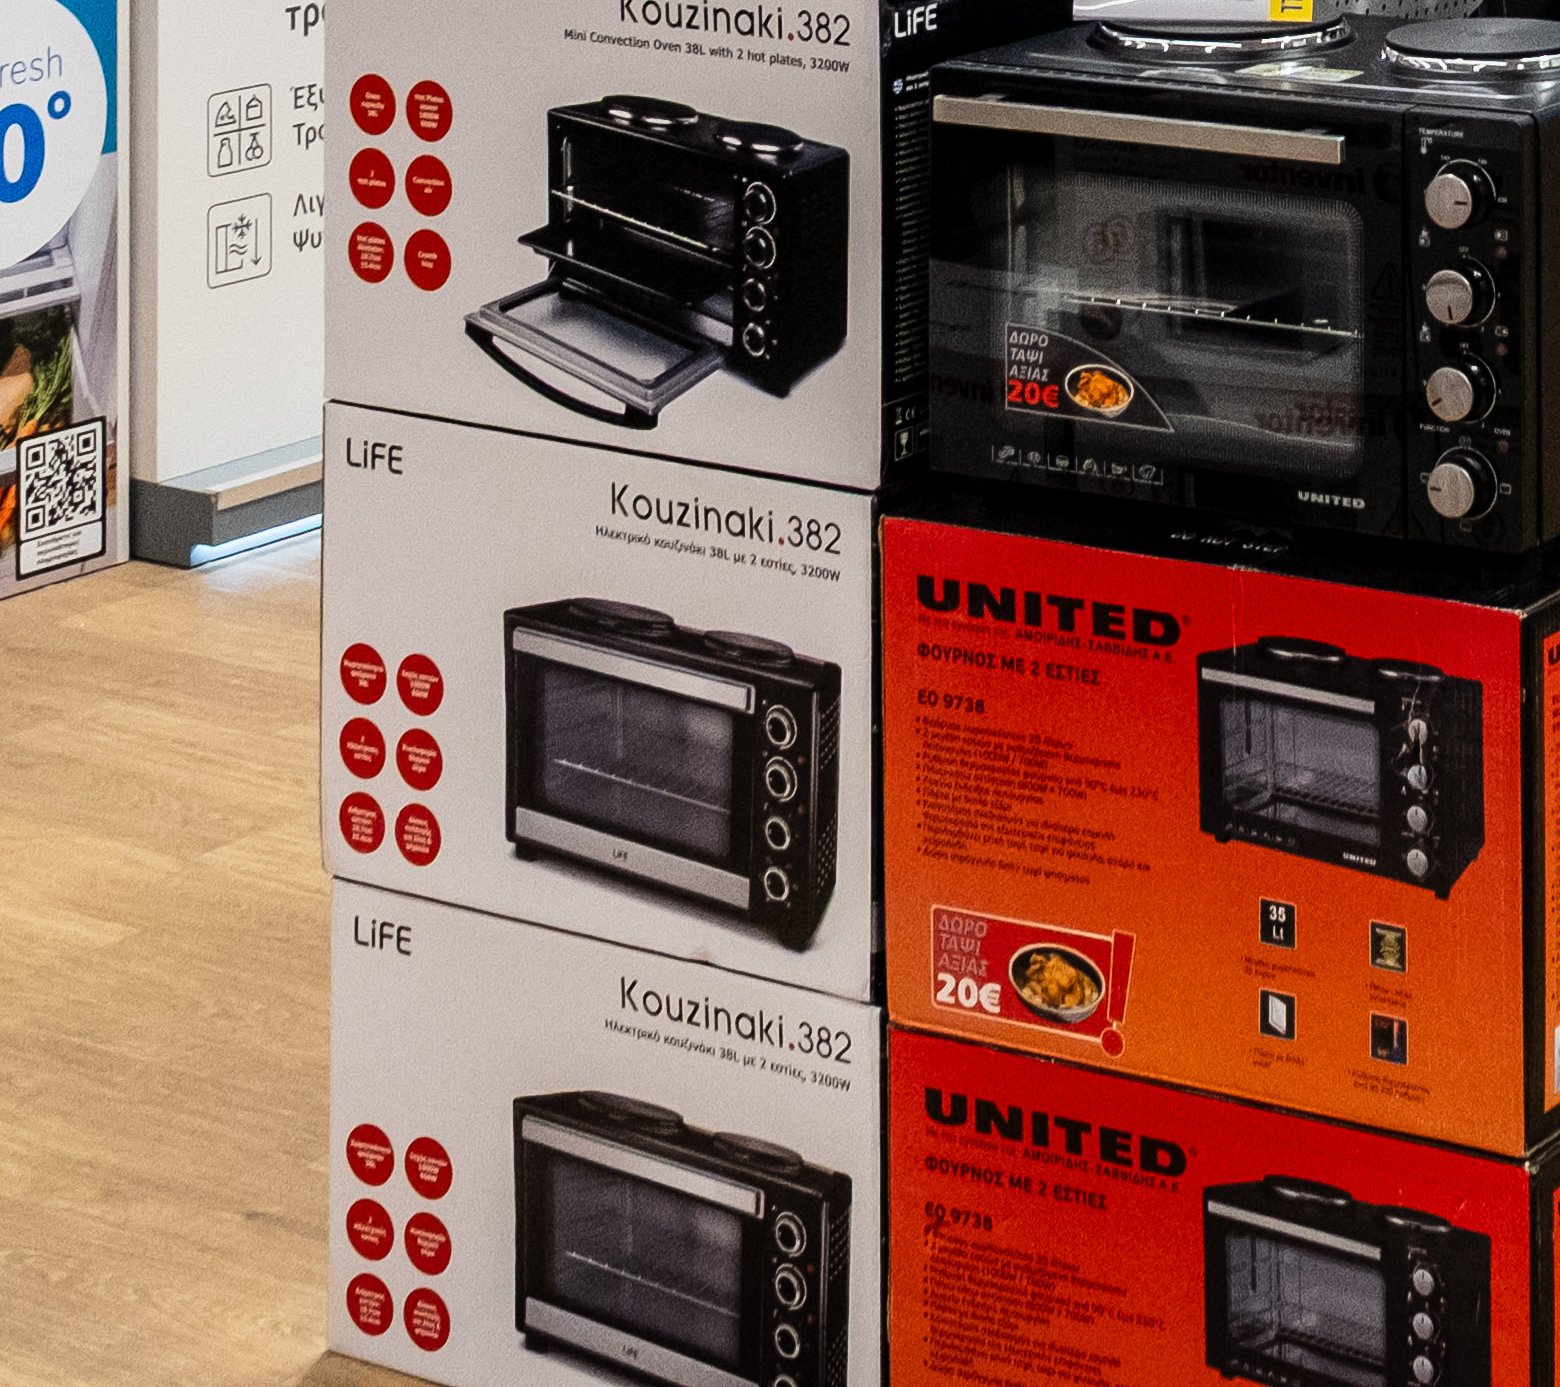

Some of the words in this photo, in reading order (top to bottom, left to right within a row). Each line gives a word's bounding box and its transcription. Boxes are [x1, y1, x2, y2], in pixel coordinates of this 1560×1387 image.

[894, 2, 938, 39] LiFE
[563, 28, 588, 44] Mini
[589, 30, 651, 50] Convection
[653, 37, 683, 53] Oven
[685, 41, 708, 57] 38L
[708, 43, 735, 60] with
[746, 48, 766, 63] hot
[768, 51, 807, 70] plates,
[1008, 329, 1049, 347] ΔΩΡΟ
[1008, 346, 1044, 365] ΤΑΨΙ
[1008, 365, 1049, 383] ΑΞΙΑΣ
[1007, 378, 1060, 408] 20€
[345, 436, 404, 476] LiFE
[1297, 490, 1366, 509] UNITED
[610, 481, 843, 557] Kouzinaki.382
[708, 542, 731, 562] 38L
[732, 549, 748, 567] με
[759, 556, 798, 577] εστίες,
[800, 562, 842, 583] 3200W
[916, 574, 1182, 648] UNITED
[917, 642, 997, 671] ΦΟΥΡΝΟΣ
[1000, 655, 1026, 675] ΜΕ
[1030, 660, 1041, 677] 2
[1045, 662, 1102, 686] ΕΣΤΙΕΣ
[943, 694, 986, 715] 9738
[937, 914, 988, 937] ΔΩΡΟ
[1268, 904, 1287, 923] 35
[352, 915, 413, 957] LiFE
[937, 932, 982, 956] ΤΑΨΙ
[937, 953, 989, 977] ΑΞΙΑΣ
[936, 972, 1002, 1014] 20€
[619, 975, 854, 1066] Kouzinaki.382
[810, 1070, 852, 1093] 3200W
[924, 1086, 1187, 1177] UNITED
[924, 1155, 1005, 1188] ΦΟΥΡΝΟΣ
[1008, 1175, 1033, 1194] ΜΕ
[1038, 1180, 1048, 1197] 2
[1053, 1183, 1108, 1211] ΕΣΤΙΕΣ
[950, 1207, 993, 1231] 9738
